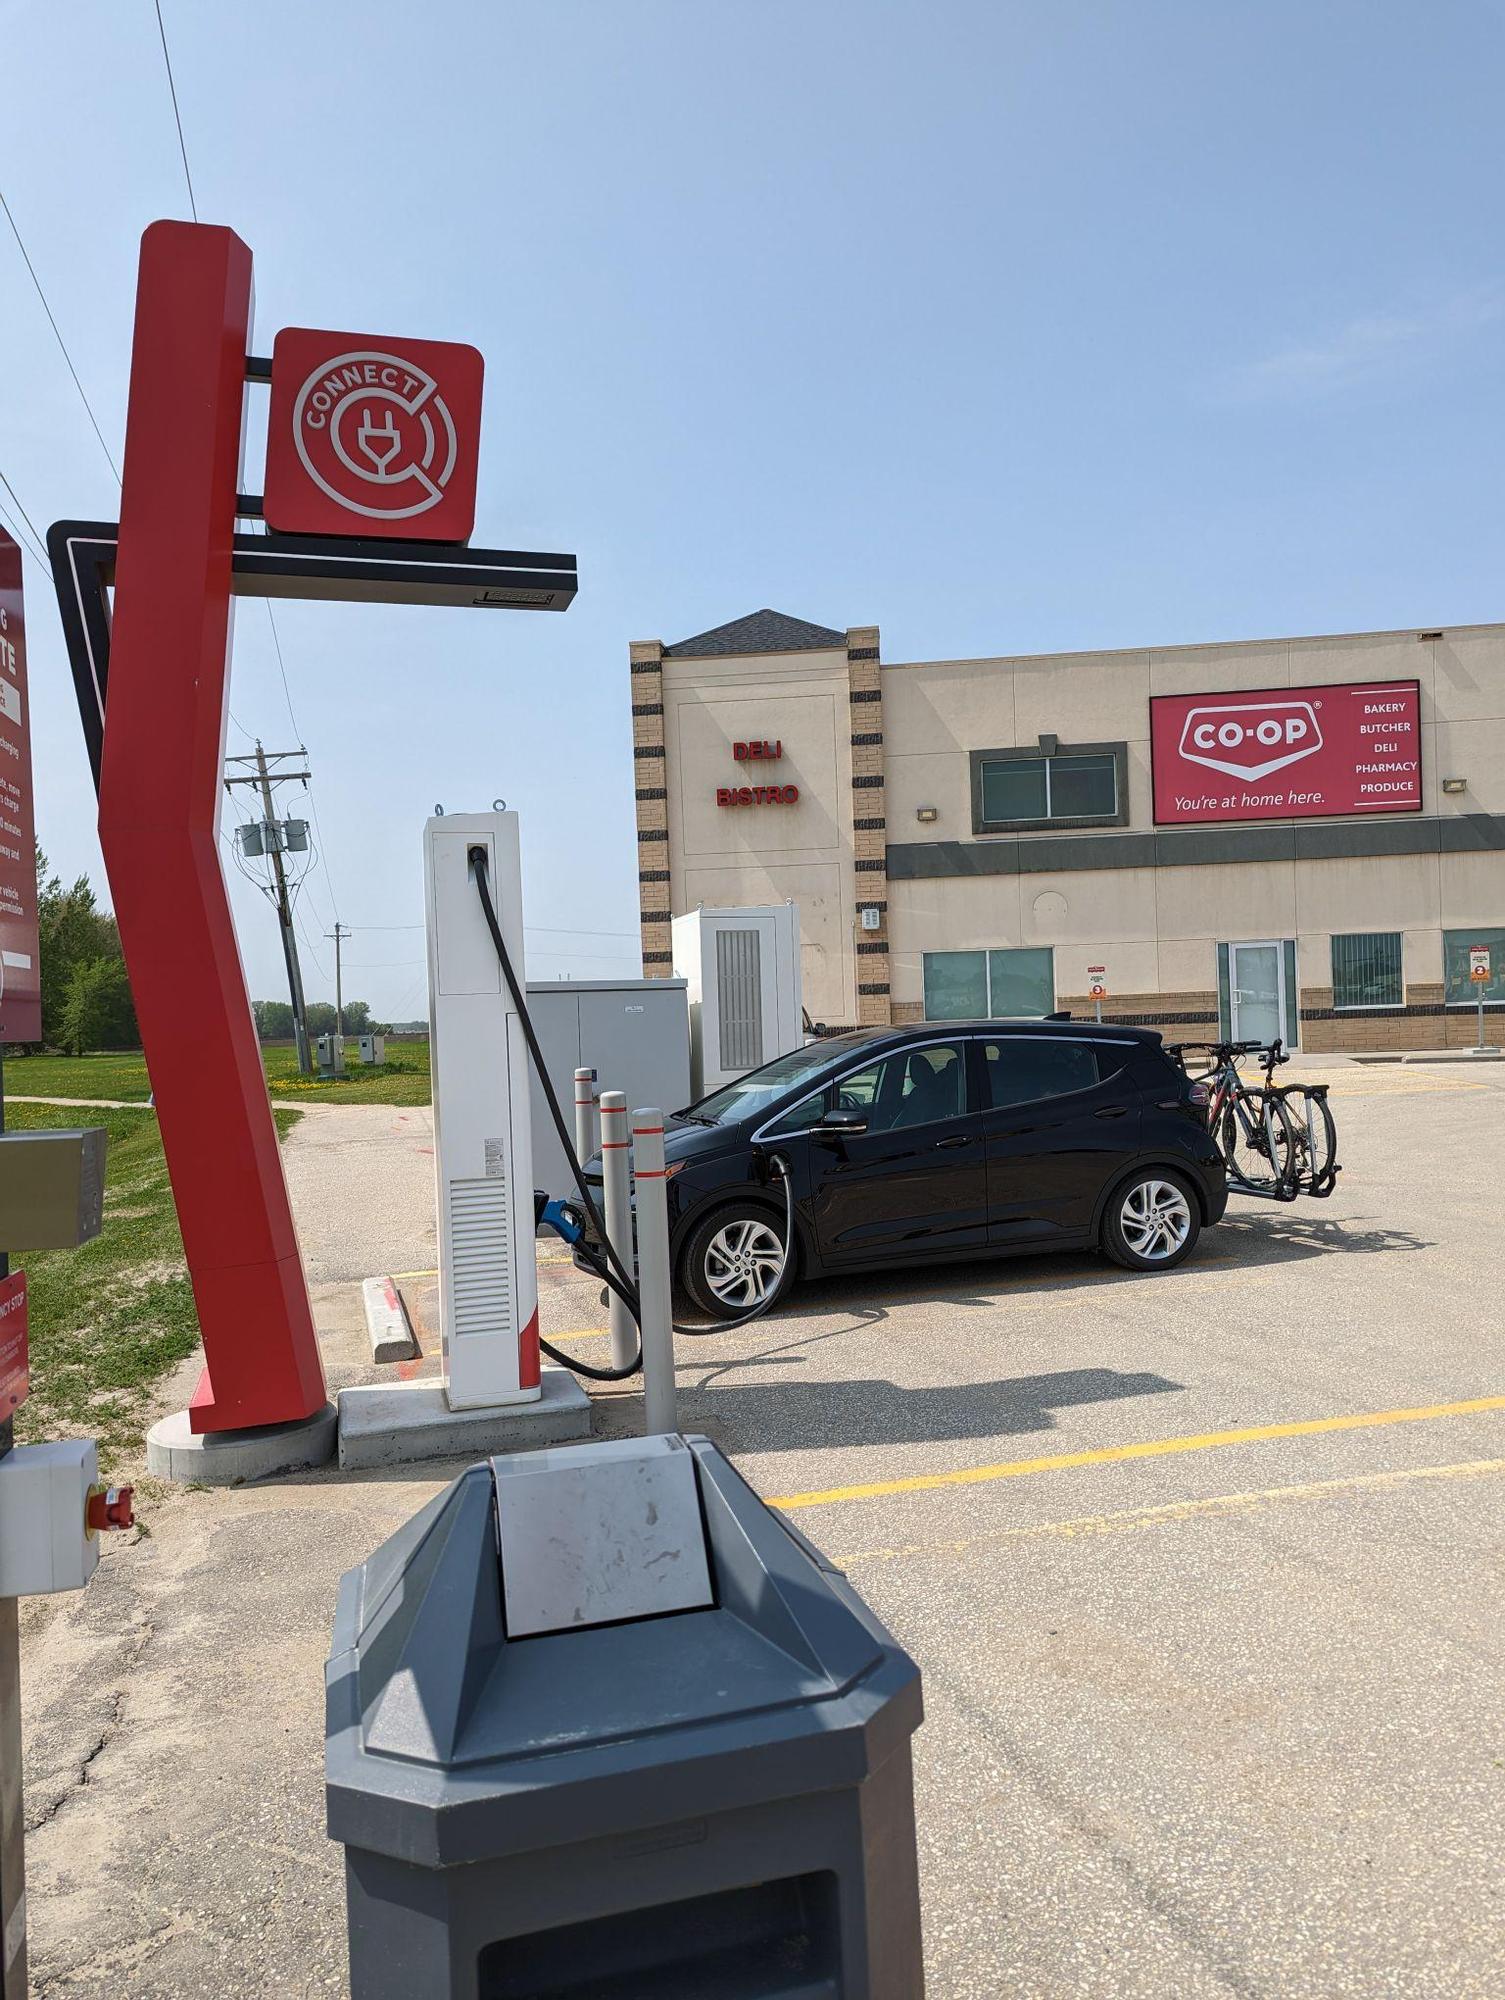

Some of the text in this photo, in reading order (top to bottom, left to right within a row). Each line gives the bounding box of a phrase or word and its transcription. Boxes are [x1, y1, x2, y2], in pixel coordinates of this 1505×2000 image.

[306, 365, 418, 429] CONNECT
[1364, 702, 1406, 714] BAKERY
[1360, 721, 1411, 734] BUTCHER
[733, 740, 782, 761] DELI
[1374, 743, 1398, 753] DELI
[1355, 761, 1418, 774] PHARMACY
[1360, 781, 1414, 793] PRODUCE
[716, 785, 799, 806] BISTRO
[1174, 789, 1325, 811] You're at home here.
[1094, 986, 1100, 994] 3
